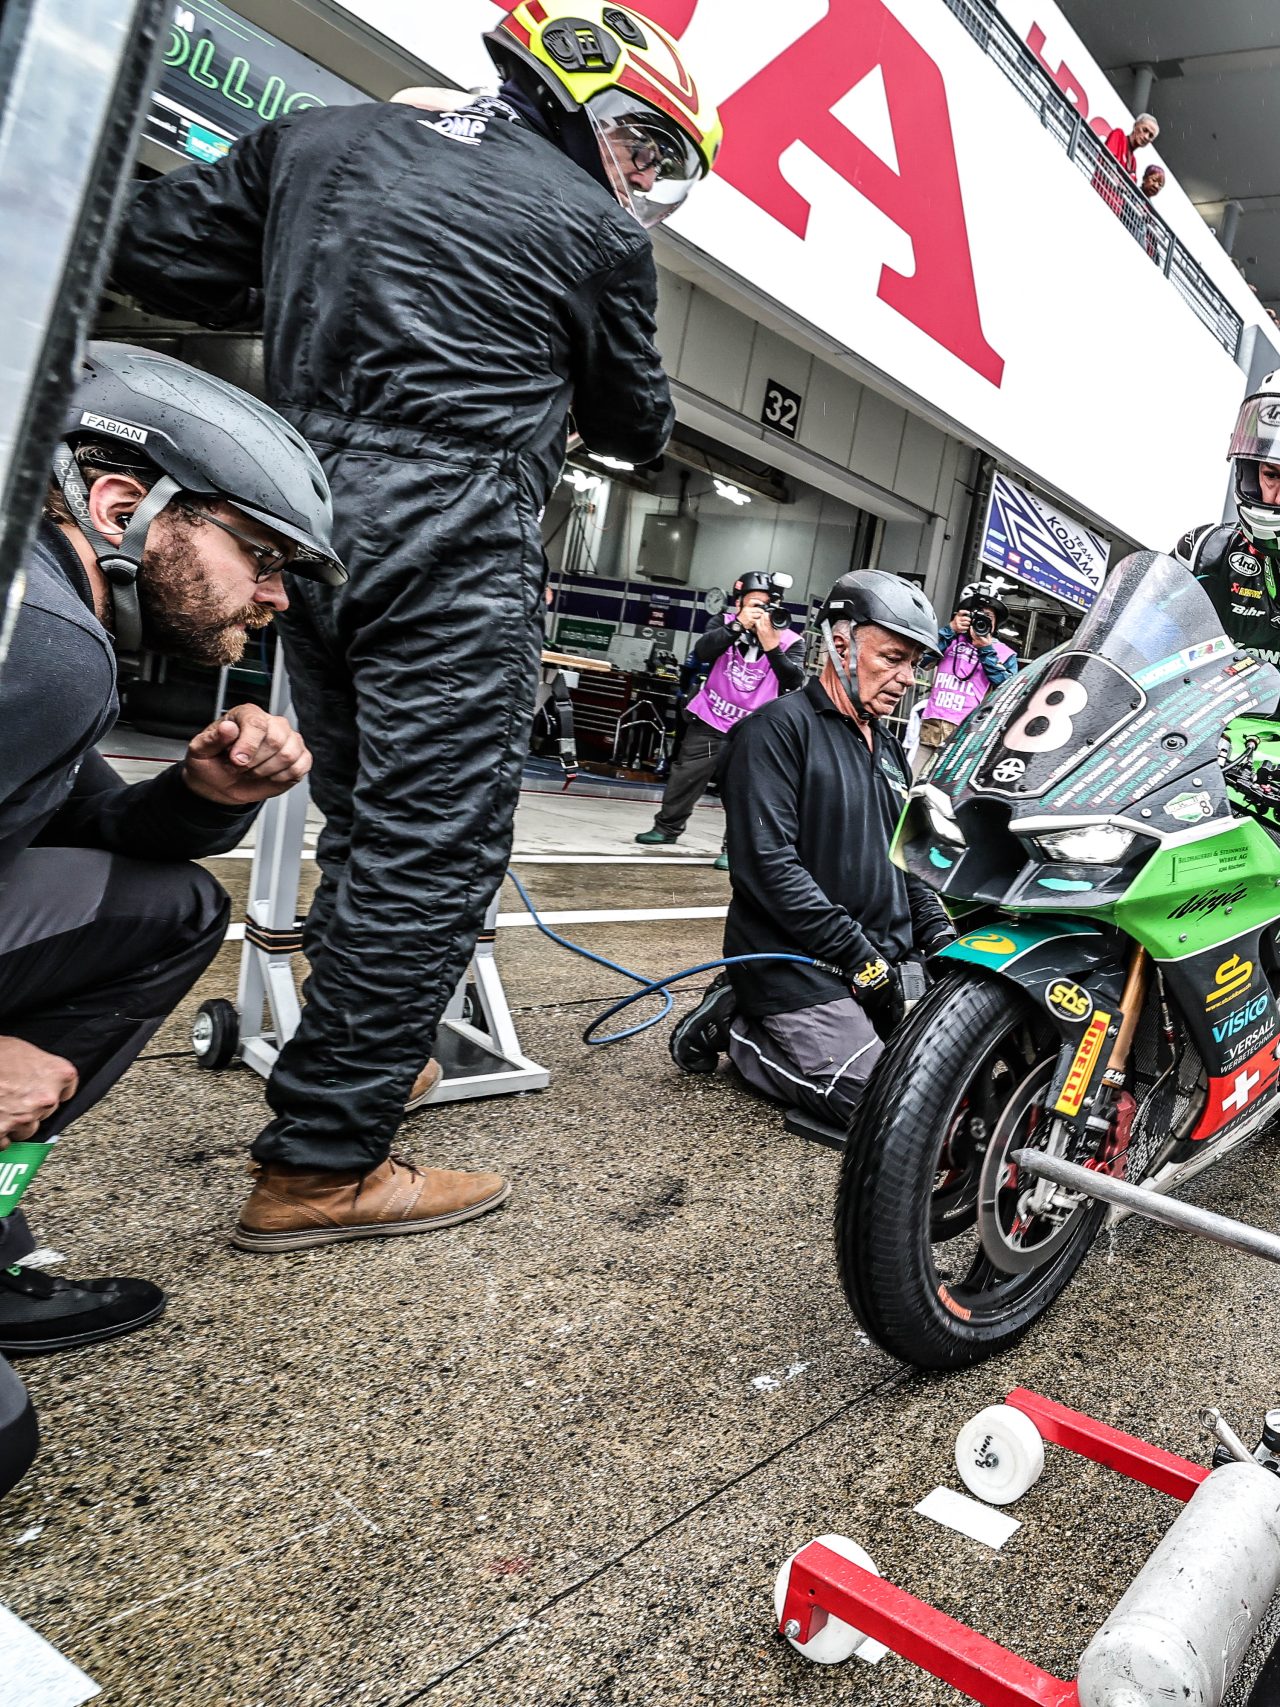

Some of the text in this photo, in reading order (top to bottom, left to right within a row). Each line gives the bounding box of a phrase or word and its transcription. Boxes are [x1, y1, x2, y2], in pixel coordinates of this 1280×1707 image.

[766, 388, 797, 426] 32
[86, 415, 142, 441] FABIAN
[1047, 516, 1099, 586] KODAMA
[1074, 535, 1094, 561] TEAM
[1231, 602, 1266, 617] Bihr
[708, 688, 753, 718] PHOT
[934, 690, 966, 712] 089
[1003, 678, 1088, 753] 8
[1167, 882, 1248, 922] Ninja
[1049, 984, 1089, 1016] sbs
[1212, 995, 1268, 1043] visico
[1220, 1029, 1276, 1074] WERBETECHNIK
[1229, 1016, 1275, 1060] VERSALL
[1062, 1019, 1107, 1107] PIRELLI
